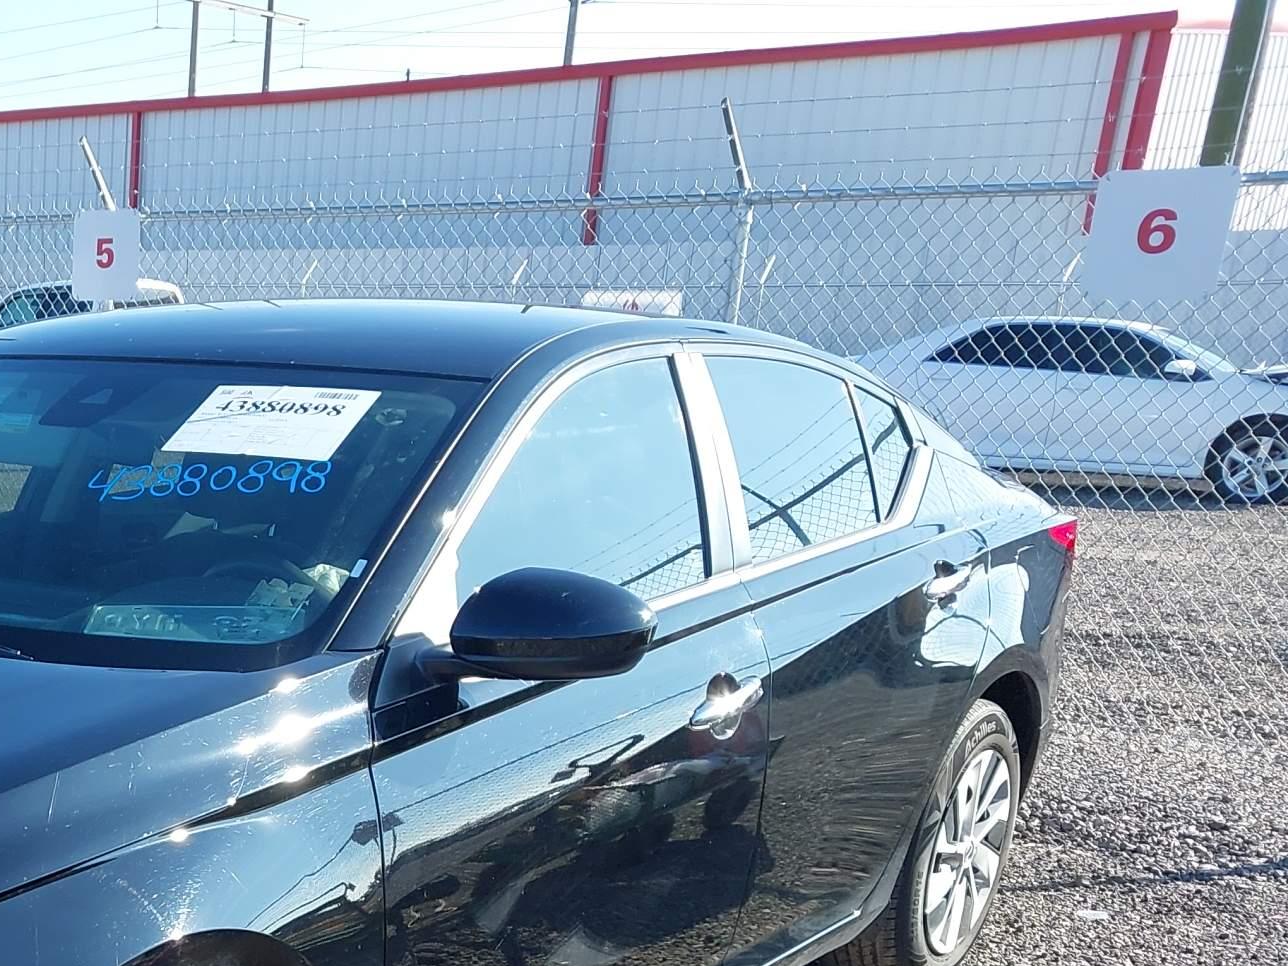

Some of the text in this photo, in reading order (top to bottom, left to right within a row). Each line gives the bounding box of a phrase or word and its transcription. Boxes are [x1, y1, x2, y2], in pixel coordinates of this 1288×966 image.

[1137, 208, 1178, 254] 6
[96, 238, 114, 269] 5
[215, 399, 346, 416] 43880898
[88, 460, 332, 502] 43880898
[964, 720, 997, 759] Achilles
